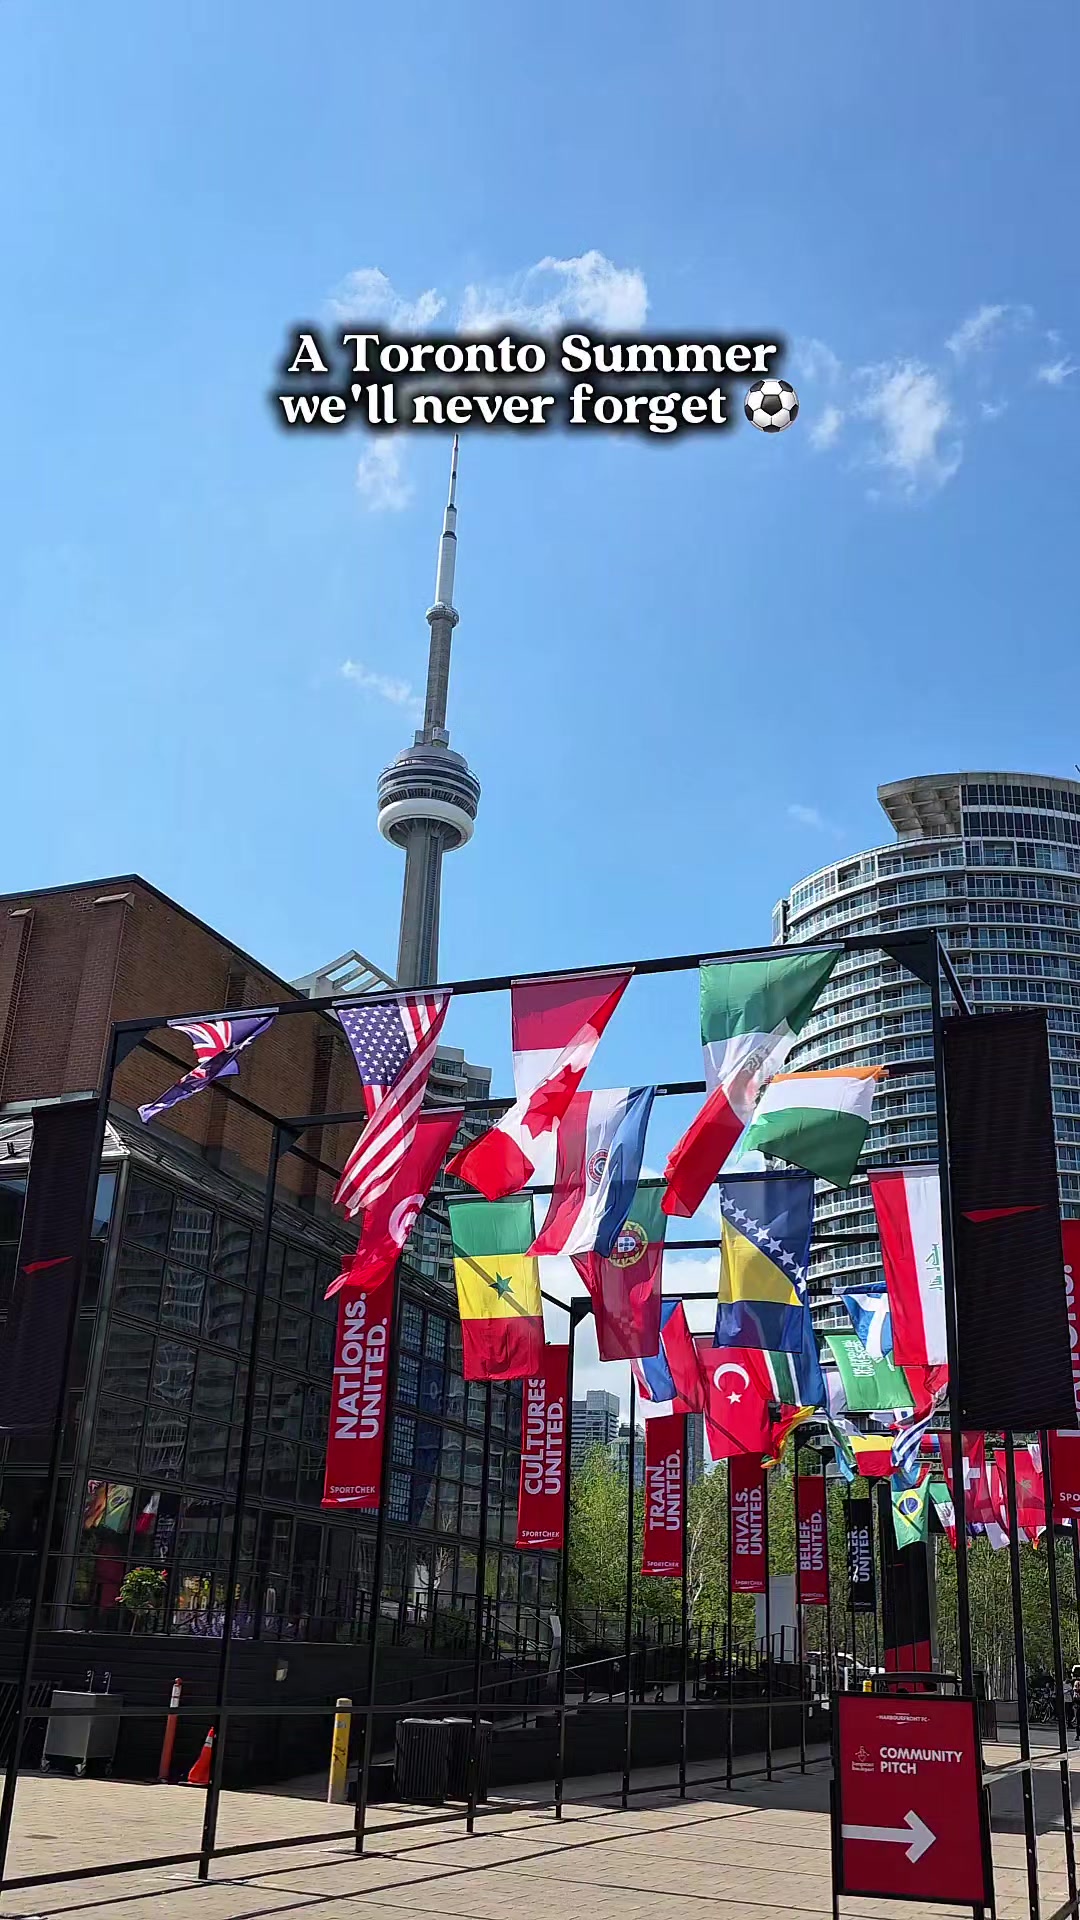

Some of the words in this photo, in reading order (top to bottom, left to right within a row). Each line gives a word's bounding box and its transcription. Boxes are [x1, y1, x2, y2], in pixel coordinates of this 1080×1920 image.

[333, 1292, 367, 1439] NATIONS.
[359, 1317, 388, 1439] UNITED.
[521, 1378, 546, 1495] CULTURES
[545, 1396, 564, 1495] UNITED.
[646, 1460, 665, 1530] TRAIN.
[666, 1449, 681, 1531] UNITED.
[731, 1487, 749, 1555] RIVALS.
[750, 1484, 763, 1555] UNITED.
[799, 1519, 812, 1571] BELIEF.
[810, 1509, 824, 1571] UNITED.
[859, 1525, 872, 1582] UNITED.
[879, 1746, 963, 1763] COMMUNITY
[880, 1761, 917, 1775] PITCH
